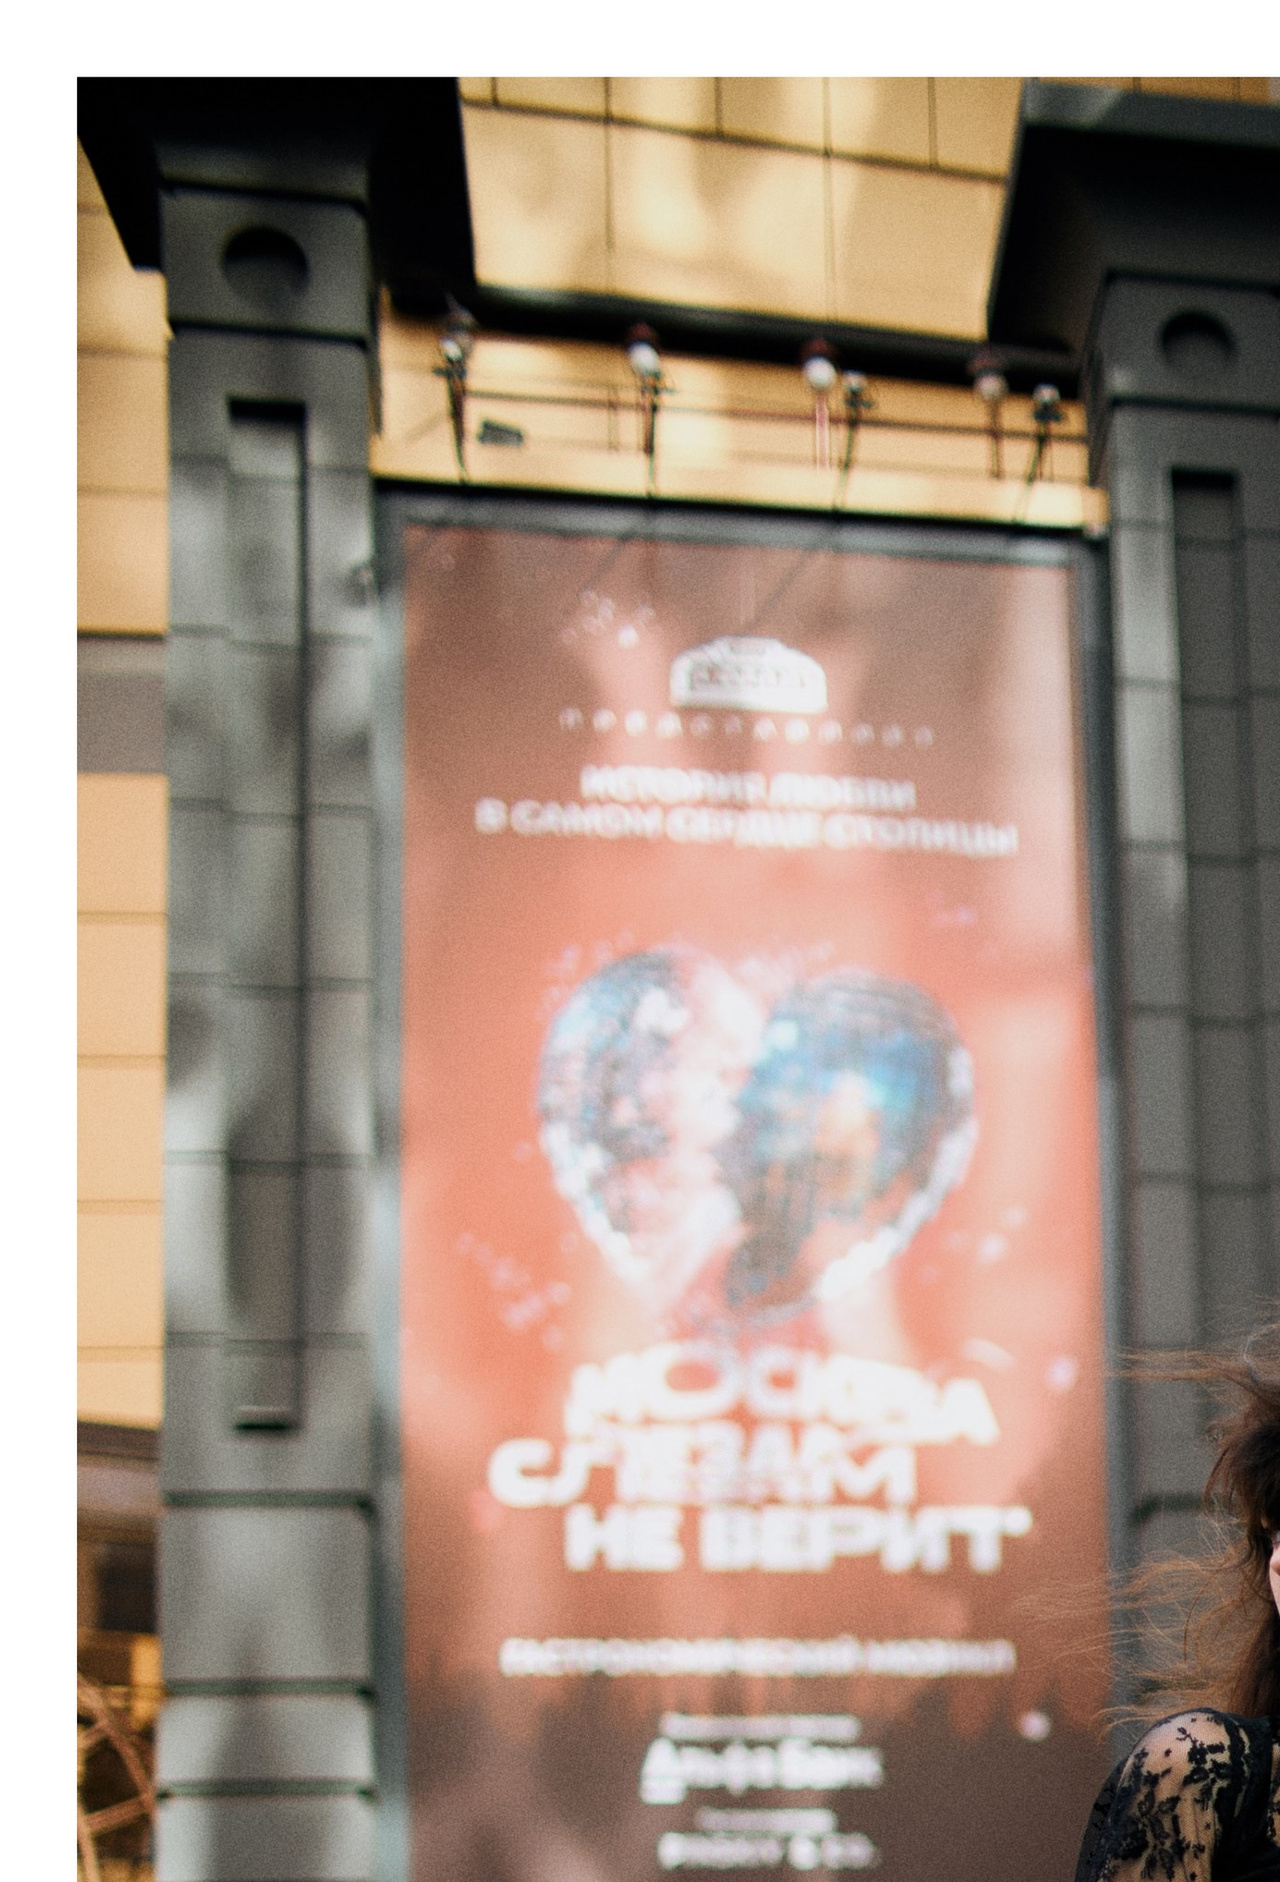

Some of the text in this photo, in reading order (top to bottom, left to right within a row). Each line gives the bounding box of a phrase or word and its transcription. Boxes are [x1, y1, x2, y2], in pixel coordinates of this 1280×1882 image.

[564, 1342, 1000, 1446] МОСКВА
[488, 1420, 917, 1507] СЛЕЗАМ
[564, 1503, 684, 1572] НЕ
